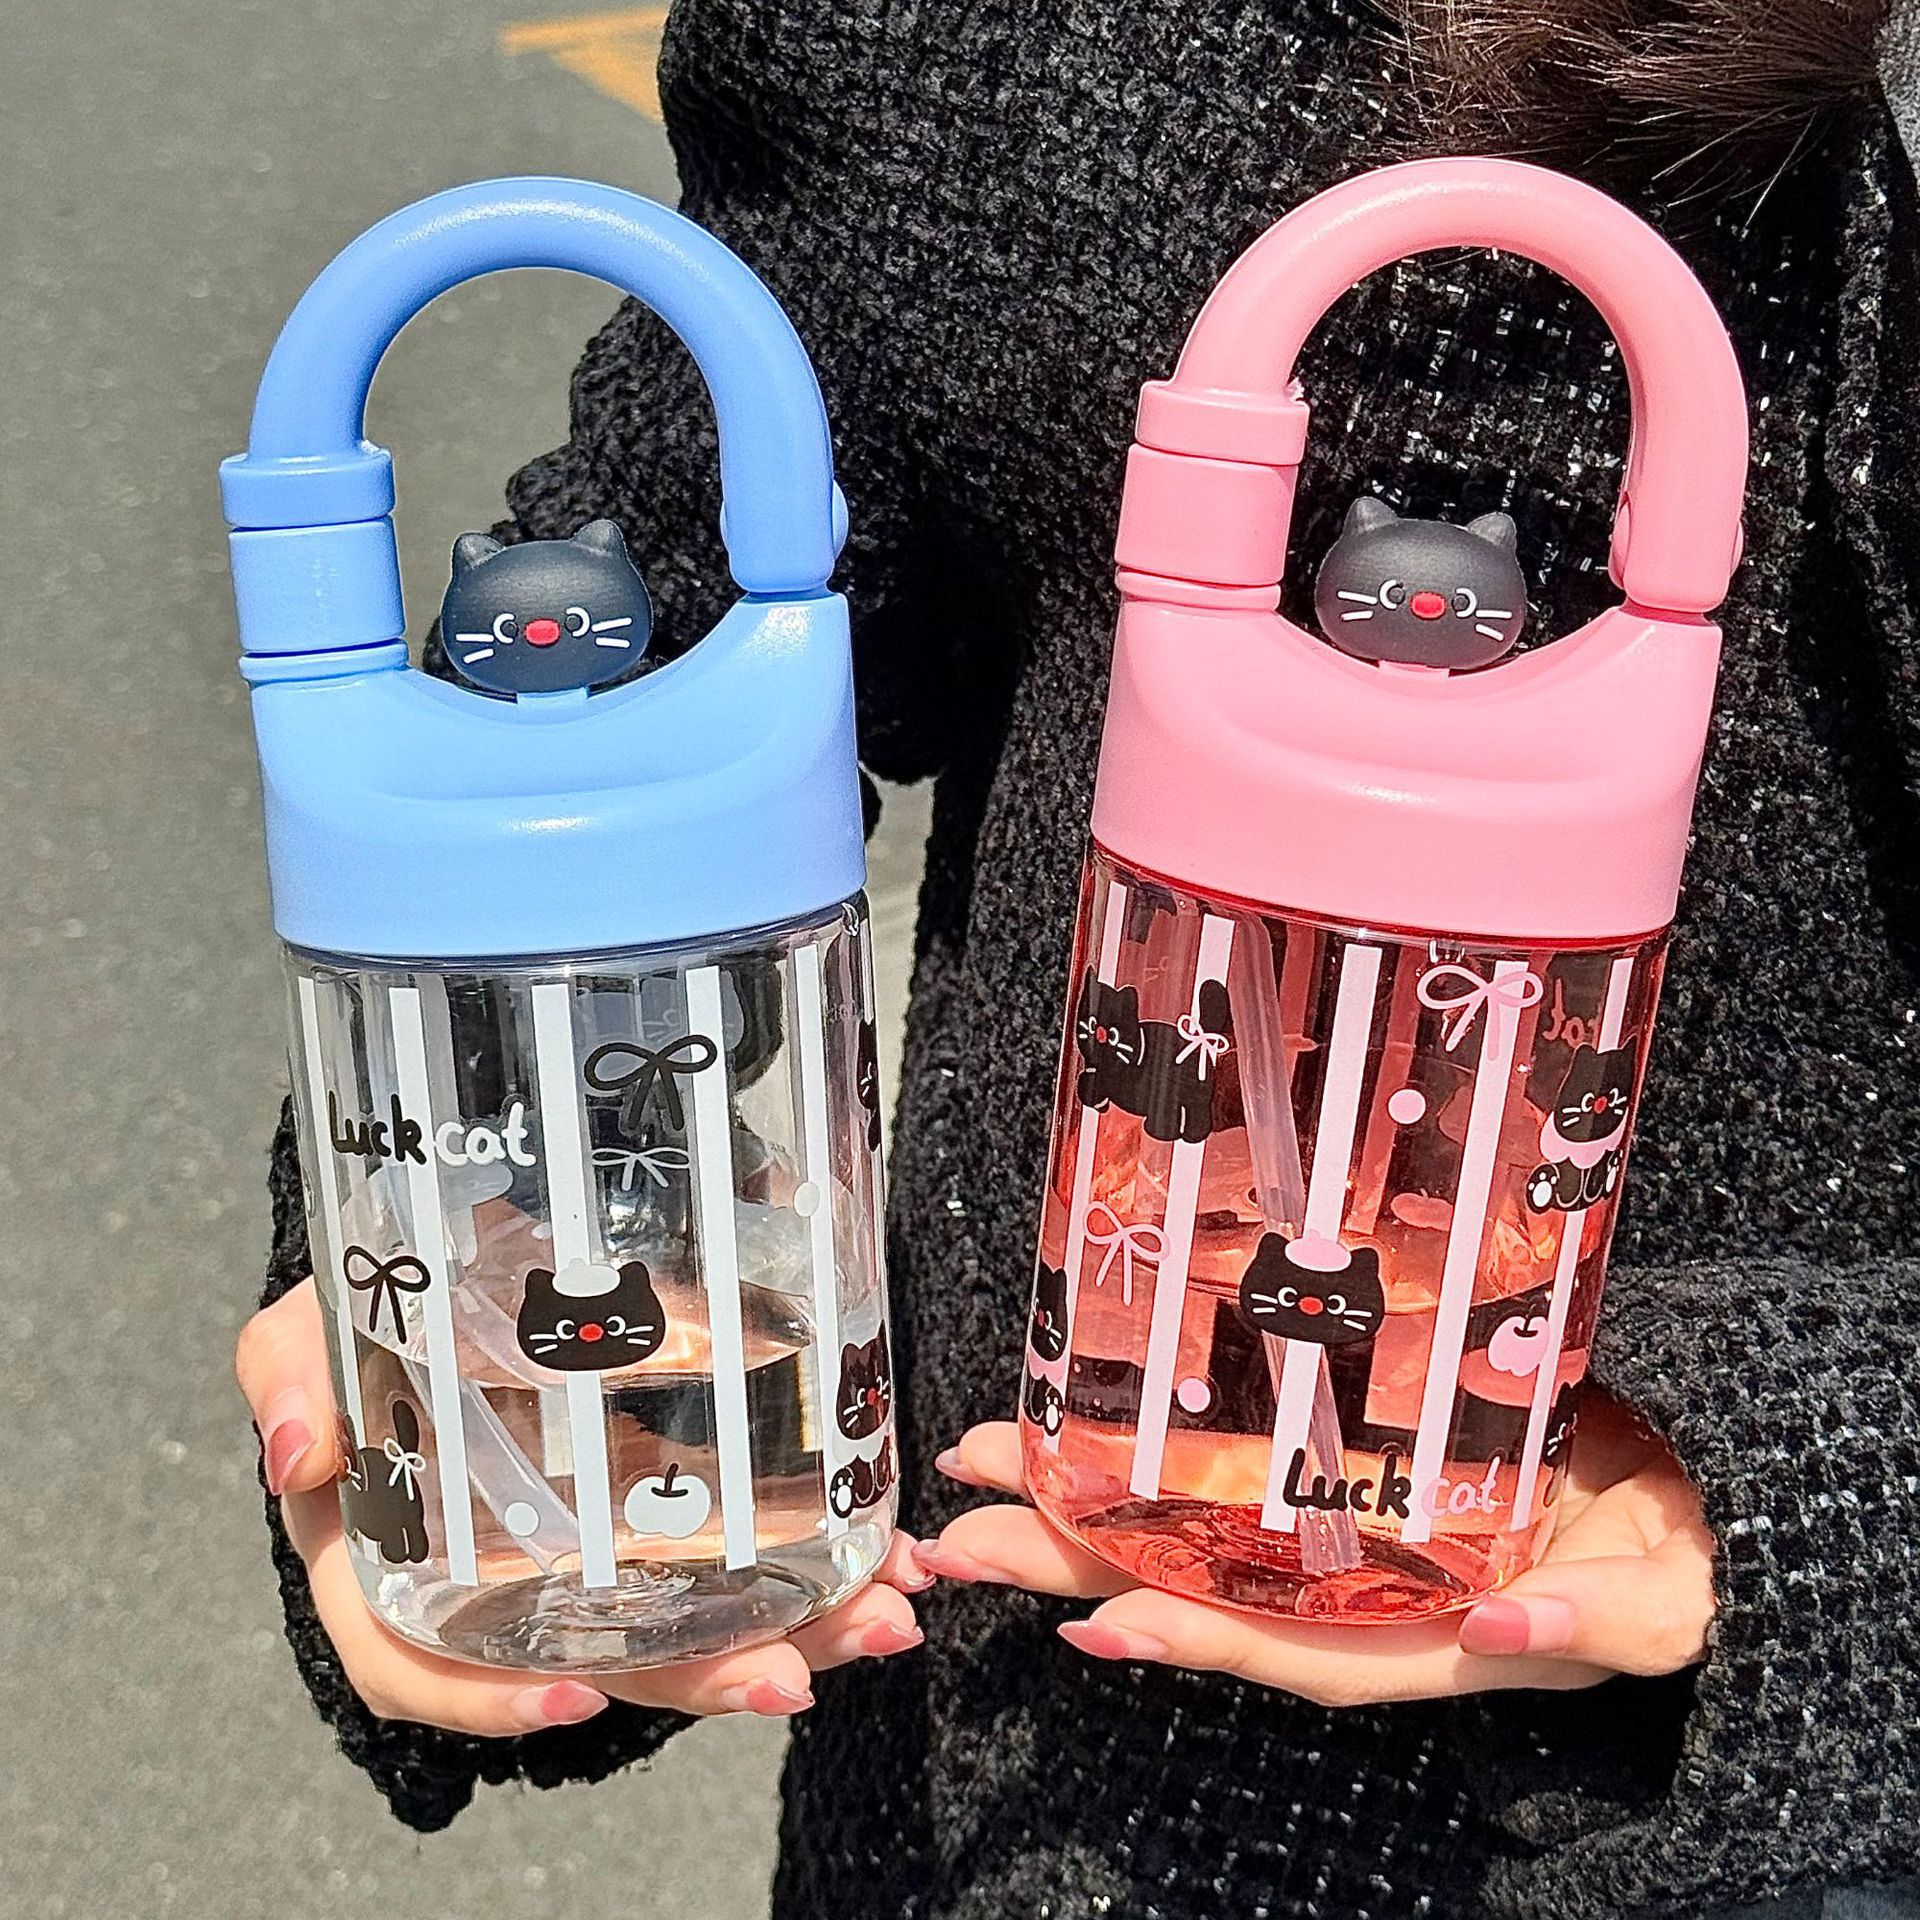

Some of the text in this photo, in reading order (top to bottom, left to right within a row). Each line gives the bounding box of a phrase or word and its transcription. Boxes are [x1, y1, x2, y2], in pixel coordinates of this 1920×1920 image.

[435, 1101, 537, 1167] cat
[1283, 1448, 1504, 1519] Luck cat
